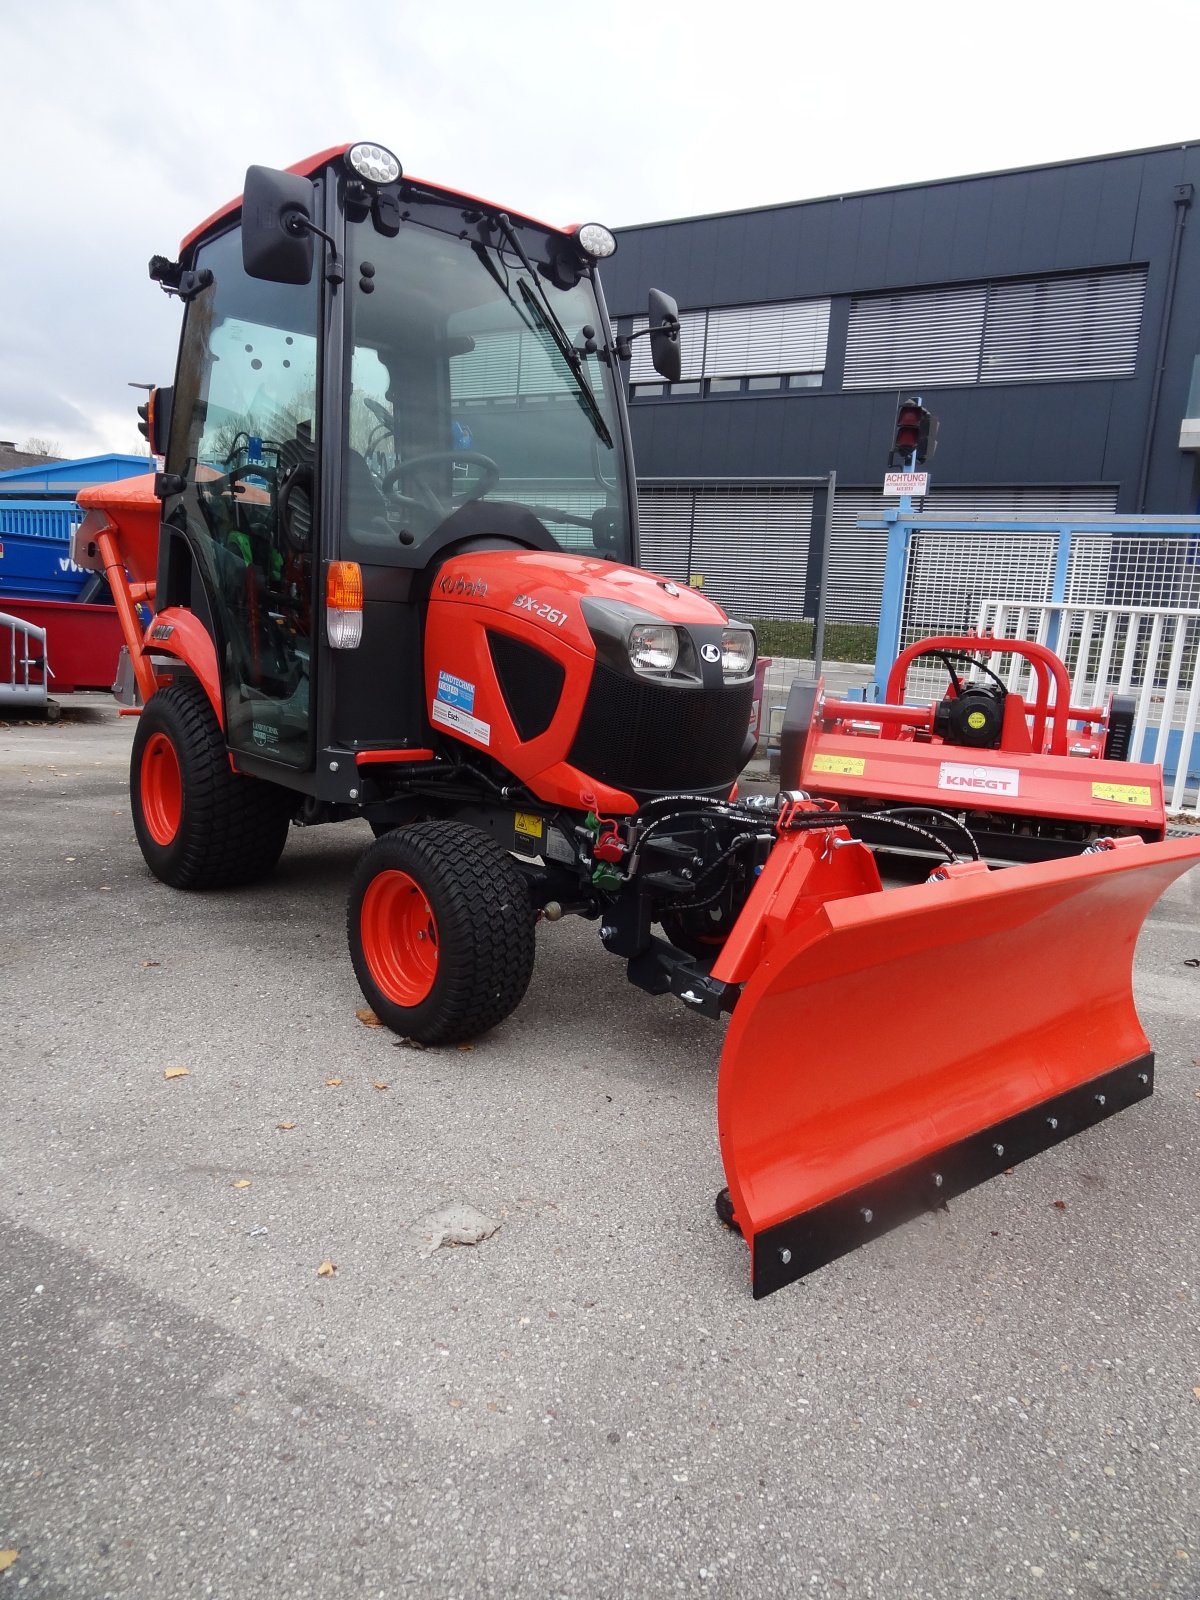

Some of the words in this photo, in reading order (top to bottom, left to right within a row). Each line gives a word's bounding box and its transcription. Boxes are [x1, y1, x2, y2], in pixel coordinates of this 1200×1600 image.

[886, 473, 927, 482] ACHTUNG!
[439, 575, 488, 598] Kubota
[512, 593, 568, 627] BX-261
[946, 775, 1012, 791] KNEGT
